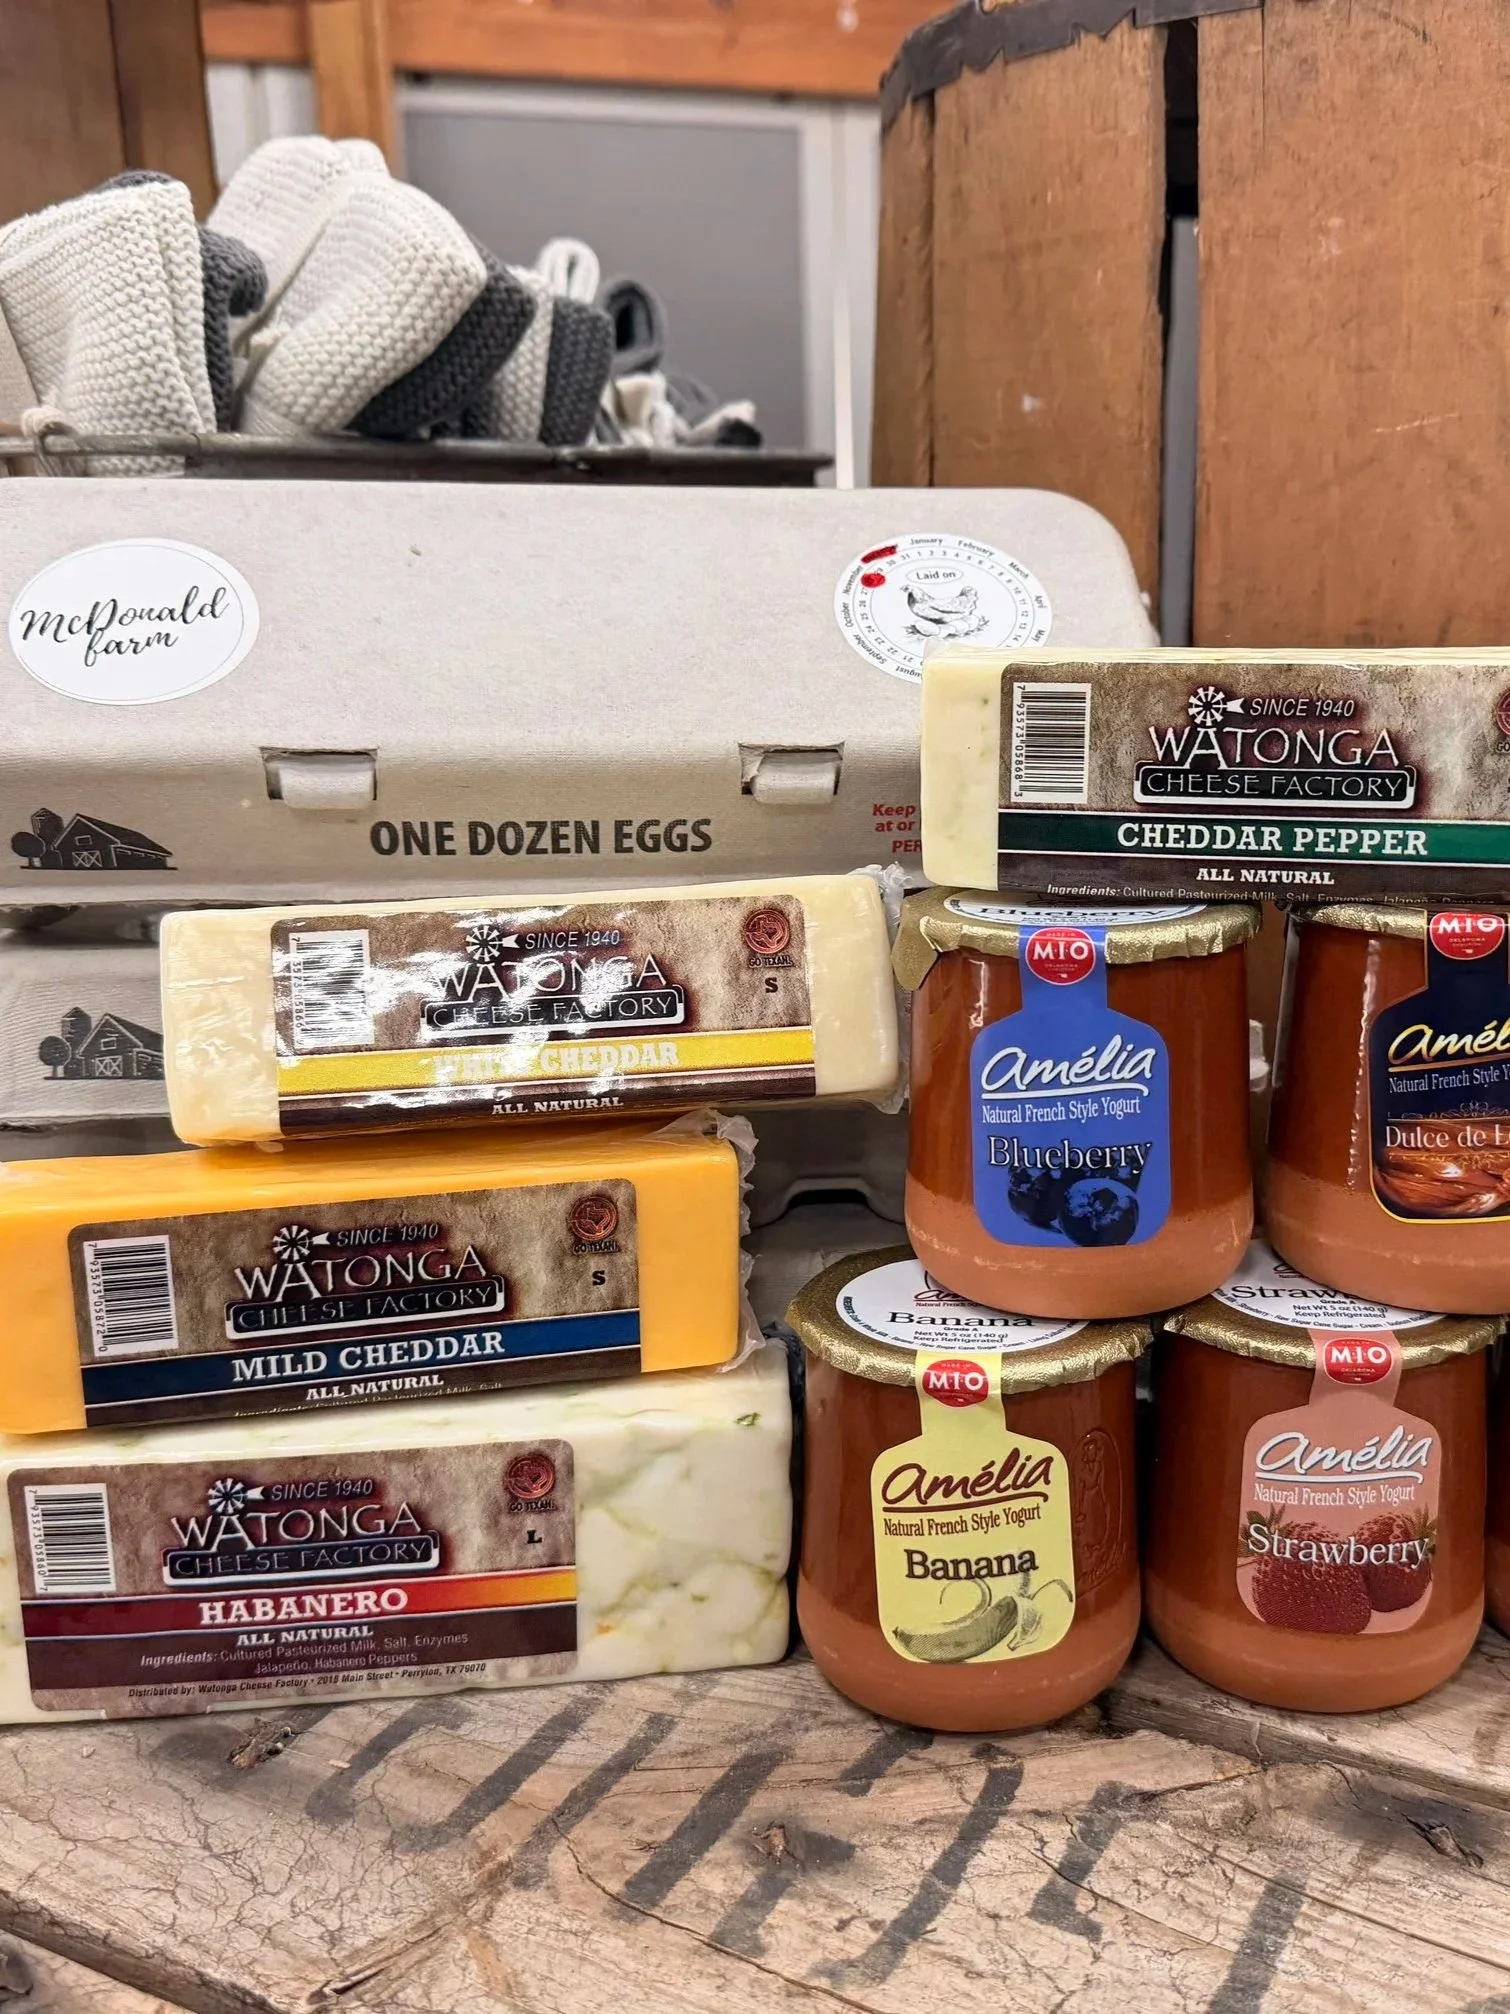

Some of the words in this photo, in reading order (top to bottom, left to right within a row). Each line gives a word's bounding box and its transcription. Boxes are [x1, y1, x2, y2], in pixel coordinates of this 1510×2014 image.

[842, 565, 864, 596] November
[916, 570, 940, 580] Laid
[909, 538, 943, 546] January
[958, 540, 995, 558] February
[1031, 629, 1046, 643] May
[20, 585, 230, 644] McDonald
[841, 601, 854, 628] October
[84, 629, 179, 667] farm
[853, 634, 887, 664] September
[895, 665, 923, 678] ugust
[1015, 703, 1025, 739] 93573
[1249, 698, 1309, 717] SINCE
[1314, 699, 1355, 718] 1940
[1014, 745, 1024, 780] 05868
[1147, 725, 1400, 770] WATONGA
[1147, 773, 1260, 796] CHEESE
[1270, 775, 1404, 799] FACTORY
[872, 803, 916, 818] Keep
[369, 820, 457, 856] ONE
[469, 819, 601, 856] DOZEN
[613, 818, 713, 853] EGGS
[875, 820, 893, 833] at
[896, 821, 916, 832] or
[1117, 822, 1283, 852] CHEDDAR
[1293, 827, 1429, 857] PEPPER
[1047, 884, 1121, 898] Ingredients:
[1123, 887, 1174, 899] Cultured
[1195, 868, 1235, 882] ALL
[1240, 869, 1336, 886] NATURAL
[525, 932, 578, 949] SINCE
[585, 930, 620, 946] 1940
[749, 957, 762, 967] GO
[765, 977, 778, 993] S
[433, 1003, 542, 1028] CHEESE
[553, 996, 672, 1023] FACTORY
[540, 1042, 680, 1072] CHEDDAR
[1389, 1073, 1429, 1093] Natural
[1432, 1070, 1470, 1090] French
[1473, 1065, 1501, 1088] Style
[492, 1103, 529, 1115] ALL
[534, 1096, 625, 1113] NATURAL
[982, 1104, 1022, 1123] Natural
[1025, 1101, 1066, 1122] French
[1069, 1098, 1099, 1123] Style
[1101, 1096, 1141, 1120] Yogurt
[1386, 1125, 1450, 1148] Dulce
[1457, 1125, 1487, 1147] de
[988, 1133, 1153, 1175] Blueberry
[337, 1224, 395, 1247] SINCE
[400, 1223, 439, 1241] 1940
[90, 1260, 102, 1294] 93573
[233, 1245, 488, 1302] WATONGA
[592, 1270, 606, 1286] S
[94, 1301, 106, 1335] 05872
[239, 1301, 354, 1329] CHEESE
[366, 1286, 492, 1316] FACTORY
[888, 1312, 1035, 1327] Banana
[1323, 1311, 1386, 1319] Refrigerated
[232, 1351, 328, 1382] MILD
[339, 1331, 506, 1370] CHEDDAR
[306, 1387, 346, 1401] ALL
[349, 1374, 444, 1396] NATURAL
[271, 1481, 328, 1500] SINCE
[335, 1479, 373, 1496] 1940
[1254, 1484, 1298, 1505] Natural
[1301, 1487, 1344, 1506] French
[1347, 1487, 1376, 1509] Style
[1380, 1484, 1415, 1508] Yogurt
[31, 1506, 43, 1538] 93573
[171, 1501, 421, 1551] WATONGA
[883, 1518, 924, 1537] Natural
[927, 1515, 968, 1536] French
[971, 1512, 1000, 1540] Style
[1003, 1503, 1042, 1528] Yogurt
[526, 1530, 543, 1544] L
[1248, 1523, 1429, 1569] Strawberry
[176, 1552, 289, 1576] CHEESE
[300, 1542, 427, 1568] FACTORY
[904, 1549, 1039, 1580] Banana
[198, 1588, 409, 1625] HABANERO
[237, 1631, 276, 1646] ALL
[280, 1625, 374, 1643] NATURAL
[140, 1653, 218, 1669] Ingredients:
[220, 1648, 272, 1662] Cultured
[276, 1641, 347, 1657] Pasteurized
[415, 1633, 469, 1648] Enzymes
[315, 1656, 366, 1669] Habanero
[368, 1652, 418, 1666] Peppers
[129, 1686, 178, 1697] Distributed
[180, 1686, 195, 1696] by:
[198, 1684, 238, 1694] Watonga
[239, 1681, 273, 1691] Cheese
[275, 1678, 308, 1689] Factory
[341, 1674, 364, 1683] Main
[366, 1670, 393, 1681] Street
[445, 1666, 456, 1674] TX
